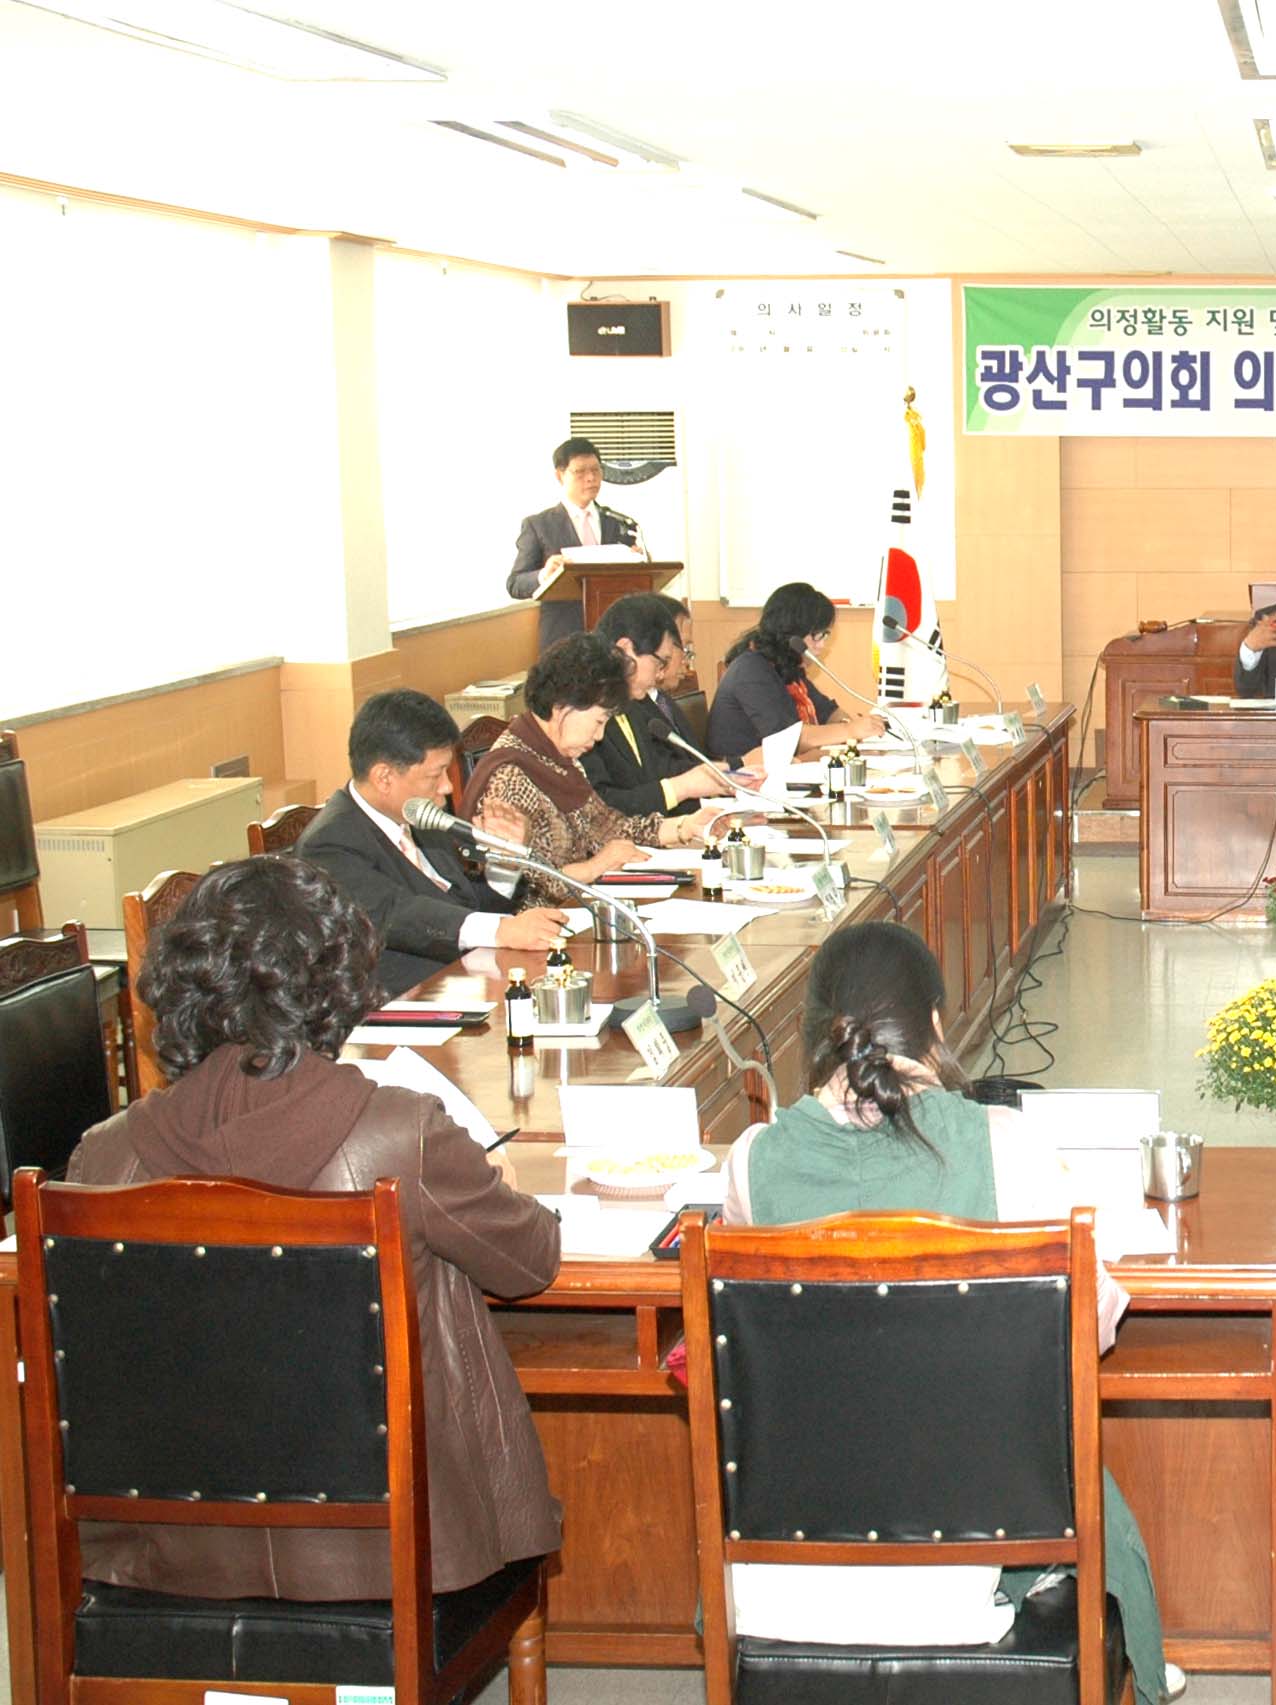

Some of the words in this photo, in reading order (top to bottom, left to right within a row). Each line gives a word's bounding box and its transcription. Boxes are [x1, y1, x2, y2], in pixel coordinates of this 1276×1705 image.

[1089, 307, 1193, 337] 의정활동
[1206, 308, 1254, 336] 지원
[980, 350, 1211, 411] 광산구의회
